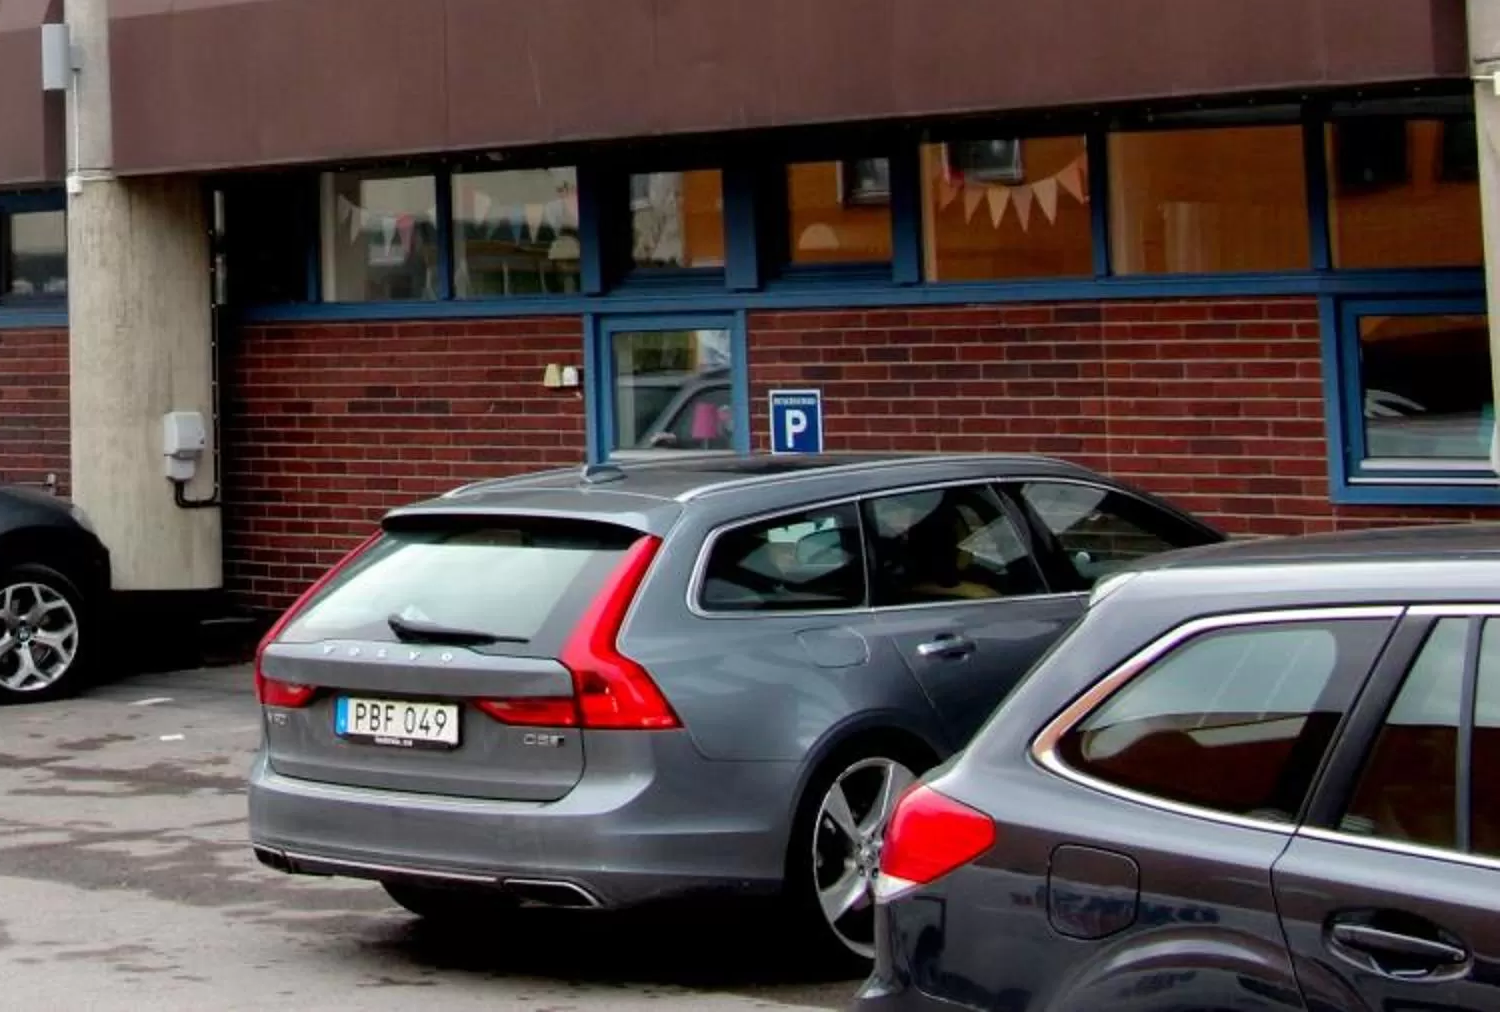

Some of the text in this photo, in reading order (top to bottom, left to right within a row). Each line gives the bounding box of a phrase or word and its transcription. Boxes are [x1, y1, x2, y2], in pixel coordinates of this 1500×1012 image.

[786, 409, 807, 448] P
[323, 646, 452, 661] VOLVO
[355, 703, 448, 736] PBF 049
